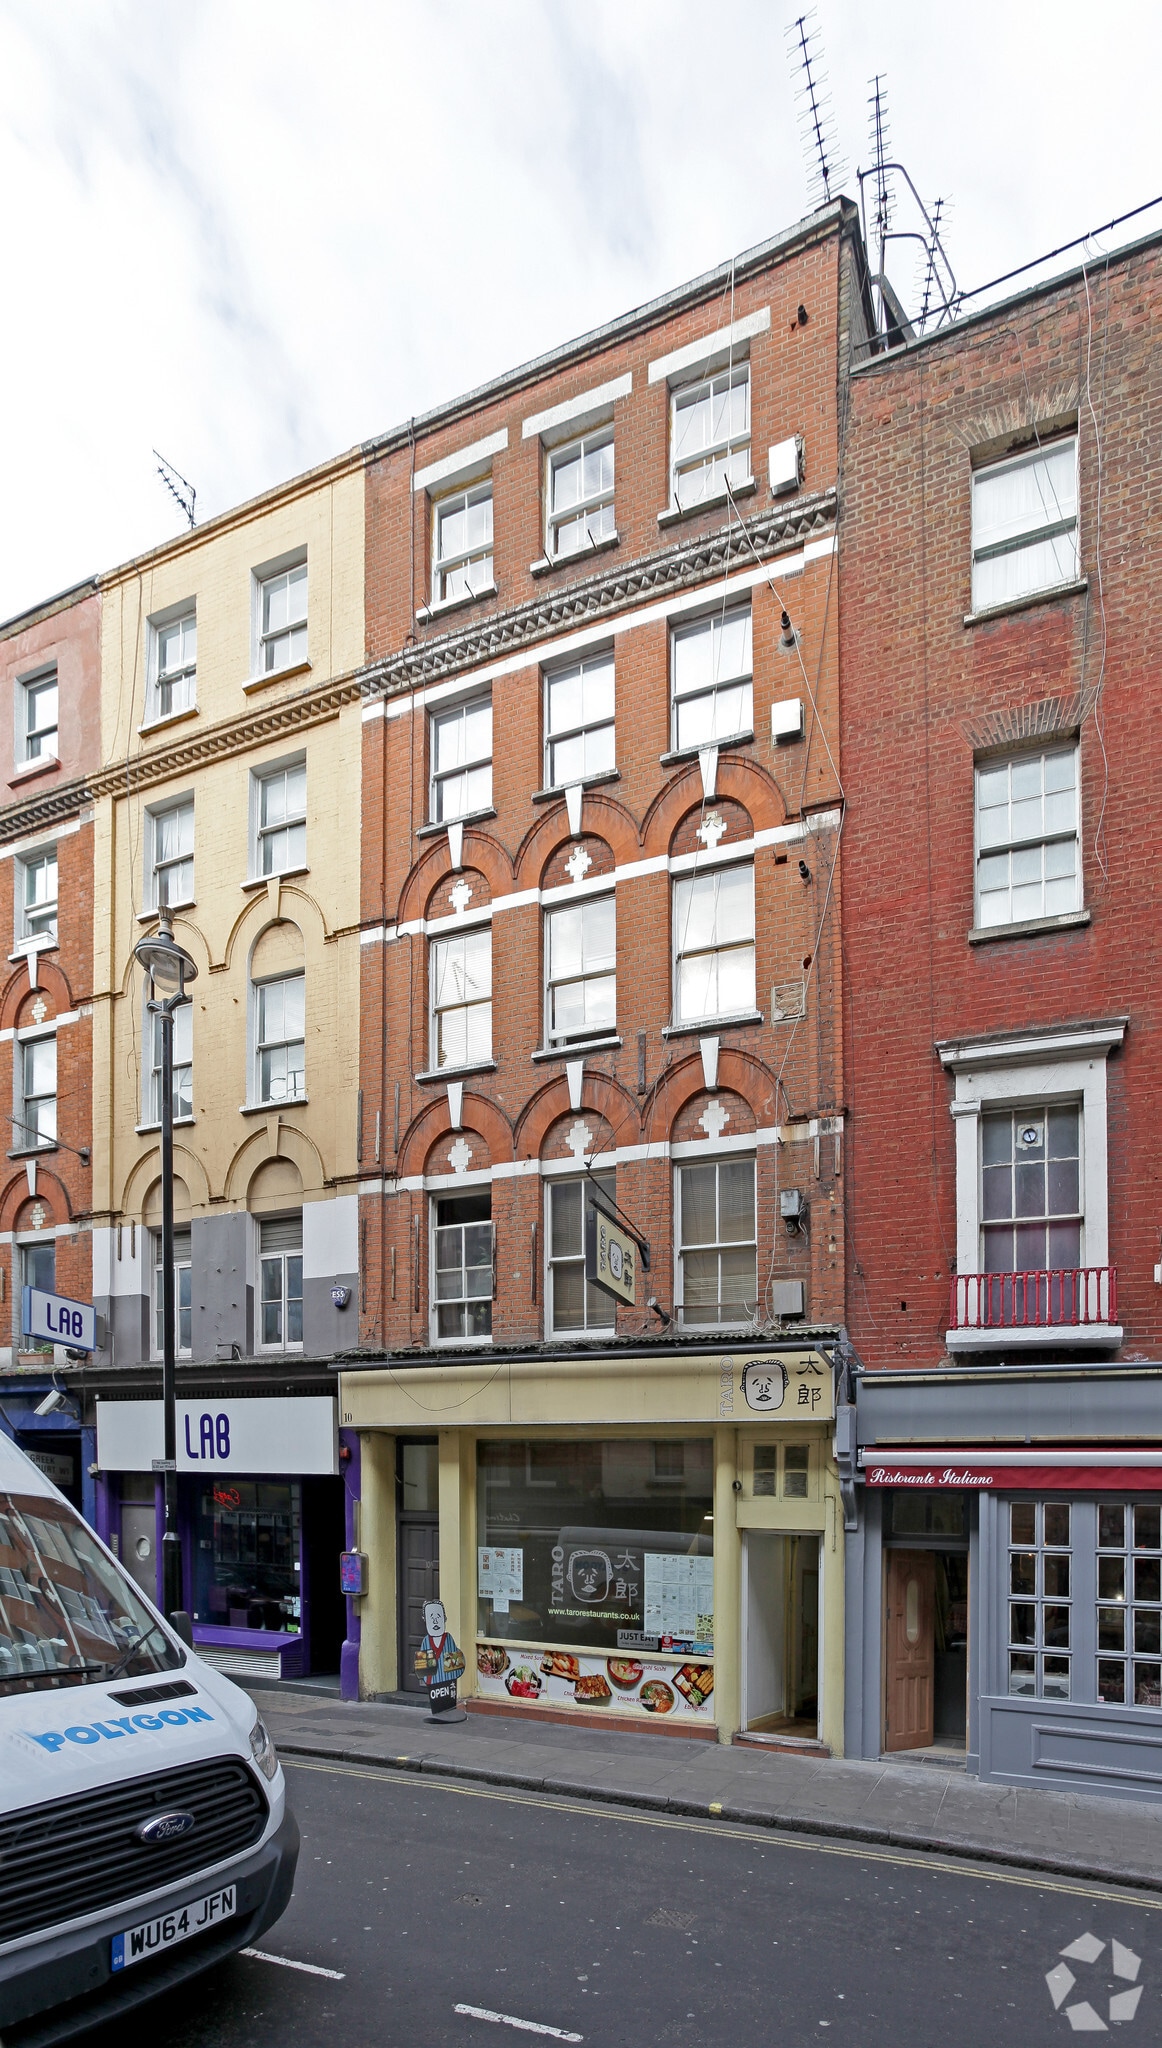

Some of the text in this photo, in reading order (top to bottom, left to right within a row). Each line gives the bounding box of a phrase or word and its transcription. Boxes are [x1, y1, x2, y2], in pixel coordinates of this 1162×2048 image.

[46, 1302, 83, 1339] LAB
[720, 1356, 734, 1417] TARO
[795, 1355, 824, 1412] 太郎
[344, 1413, 352, 1423] 10
[184, 1412, 231, 1459] LAB
[30, 1454, 55, 1464] GREEK
[869, 1468, 993, 1485] Ristorante Italiano
[551, 1545, 564, 1606] TARO
[613, 1548, 640, 1607] 太郎
[547, 1607, 640, 1620] www.tarorestaurants.co.uk
[619, 1632, 639, 1641] JUST
[430, 1686, 450, 1699] OPEN
[32, 1706, 216, 1753] POLYGON
[156, 1819, 185, 1839] Ford
[131, 1888, 233, 1957] WU64 JFN
[113, 1955, 123, 1965] GB
